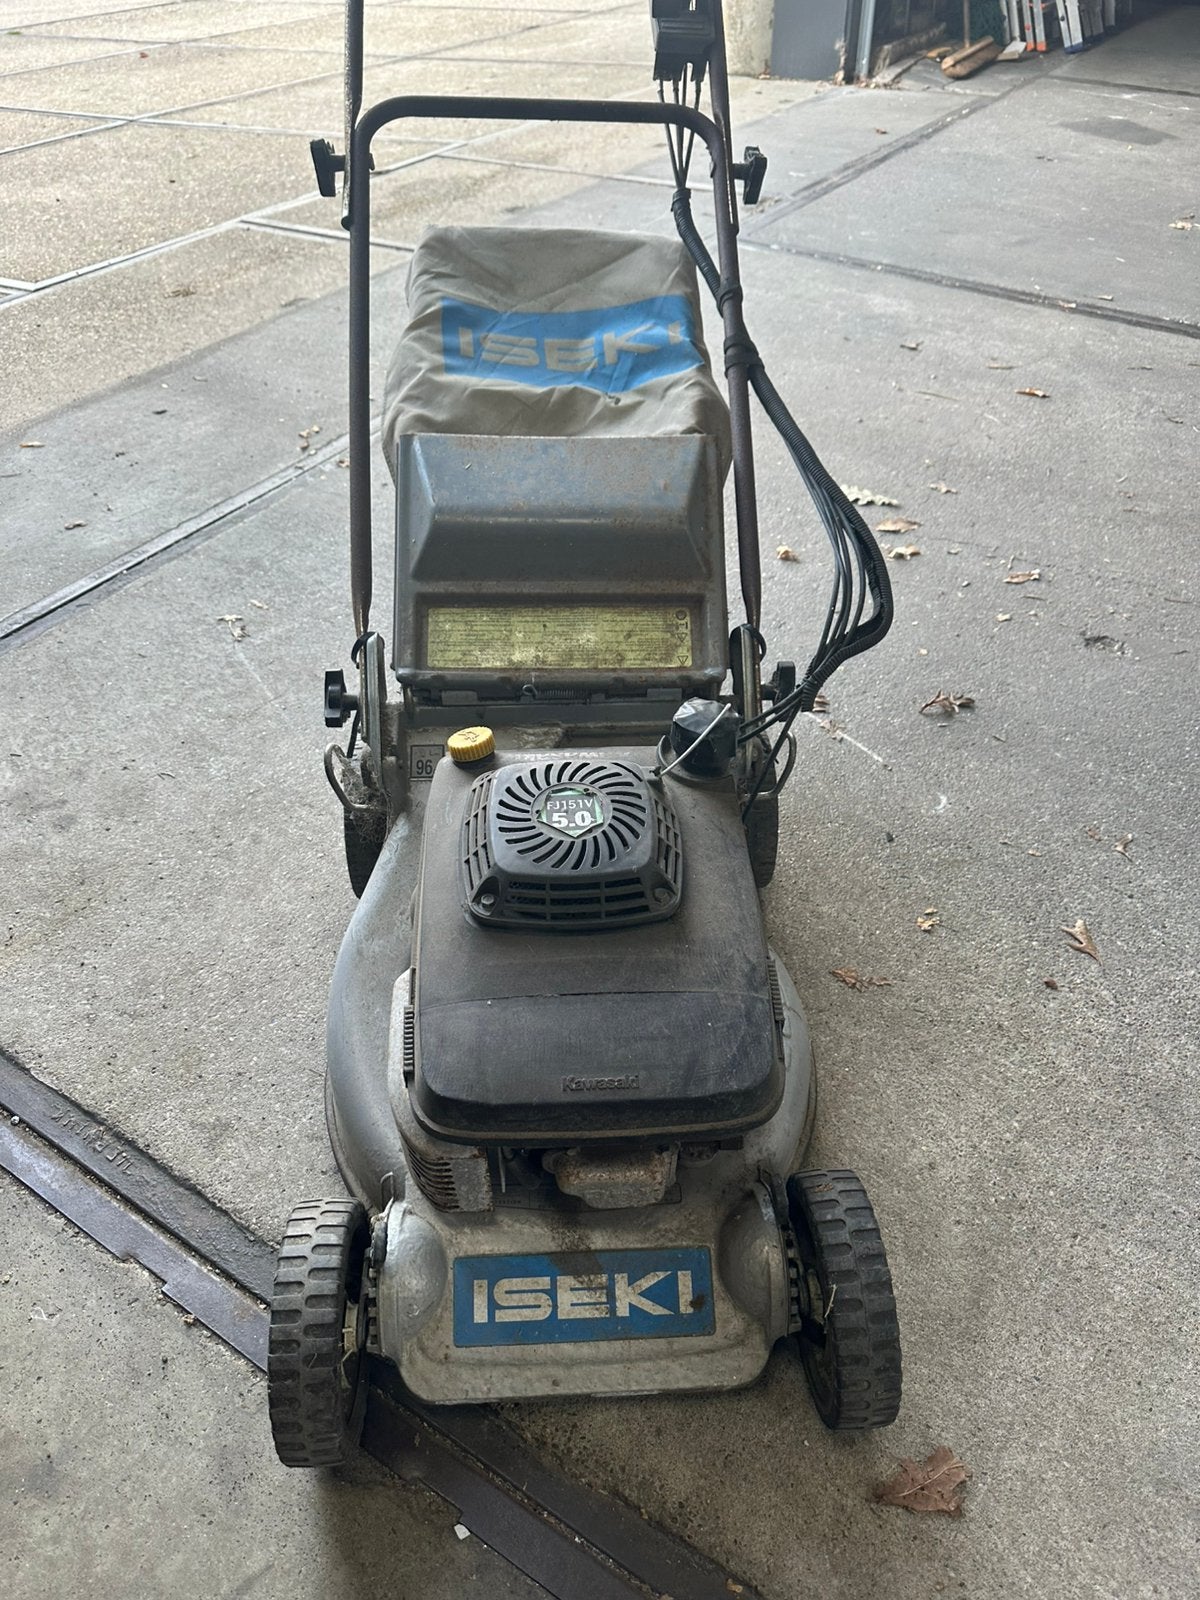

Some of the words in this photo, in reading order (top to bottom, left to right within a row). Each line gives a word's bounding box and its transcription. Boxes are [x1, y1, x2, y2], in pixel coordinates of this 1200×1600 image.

[458, 320, 683, 372] ISEKI
[416, 759, 433, 776] 96
[546, 798, 594, 811] FJ151V
[552, 810, 592, 828] 5.0
[561, 1075, 640, 1092] Kawasaki
[473, 1270, 694, 1324] ISEKI
